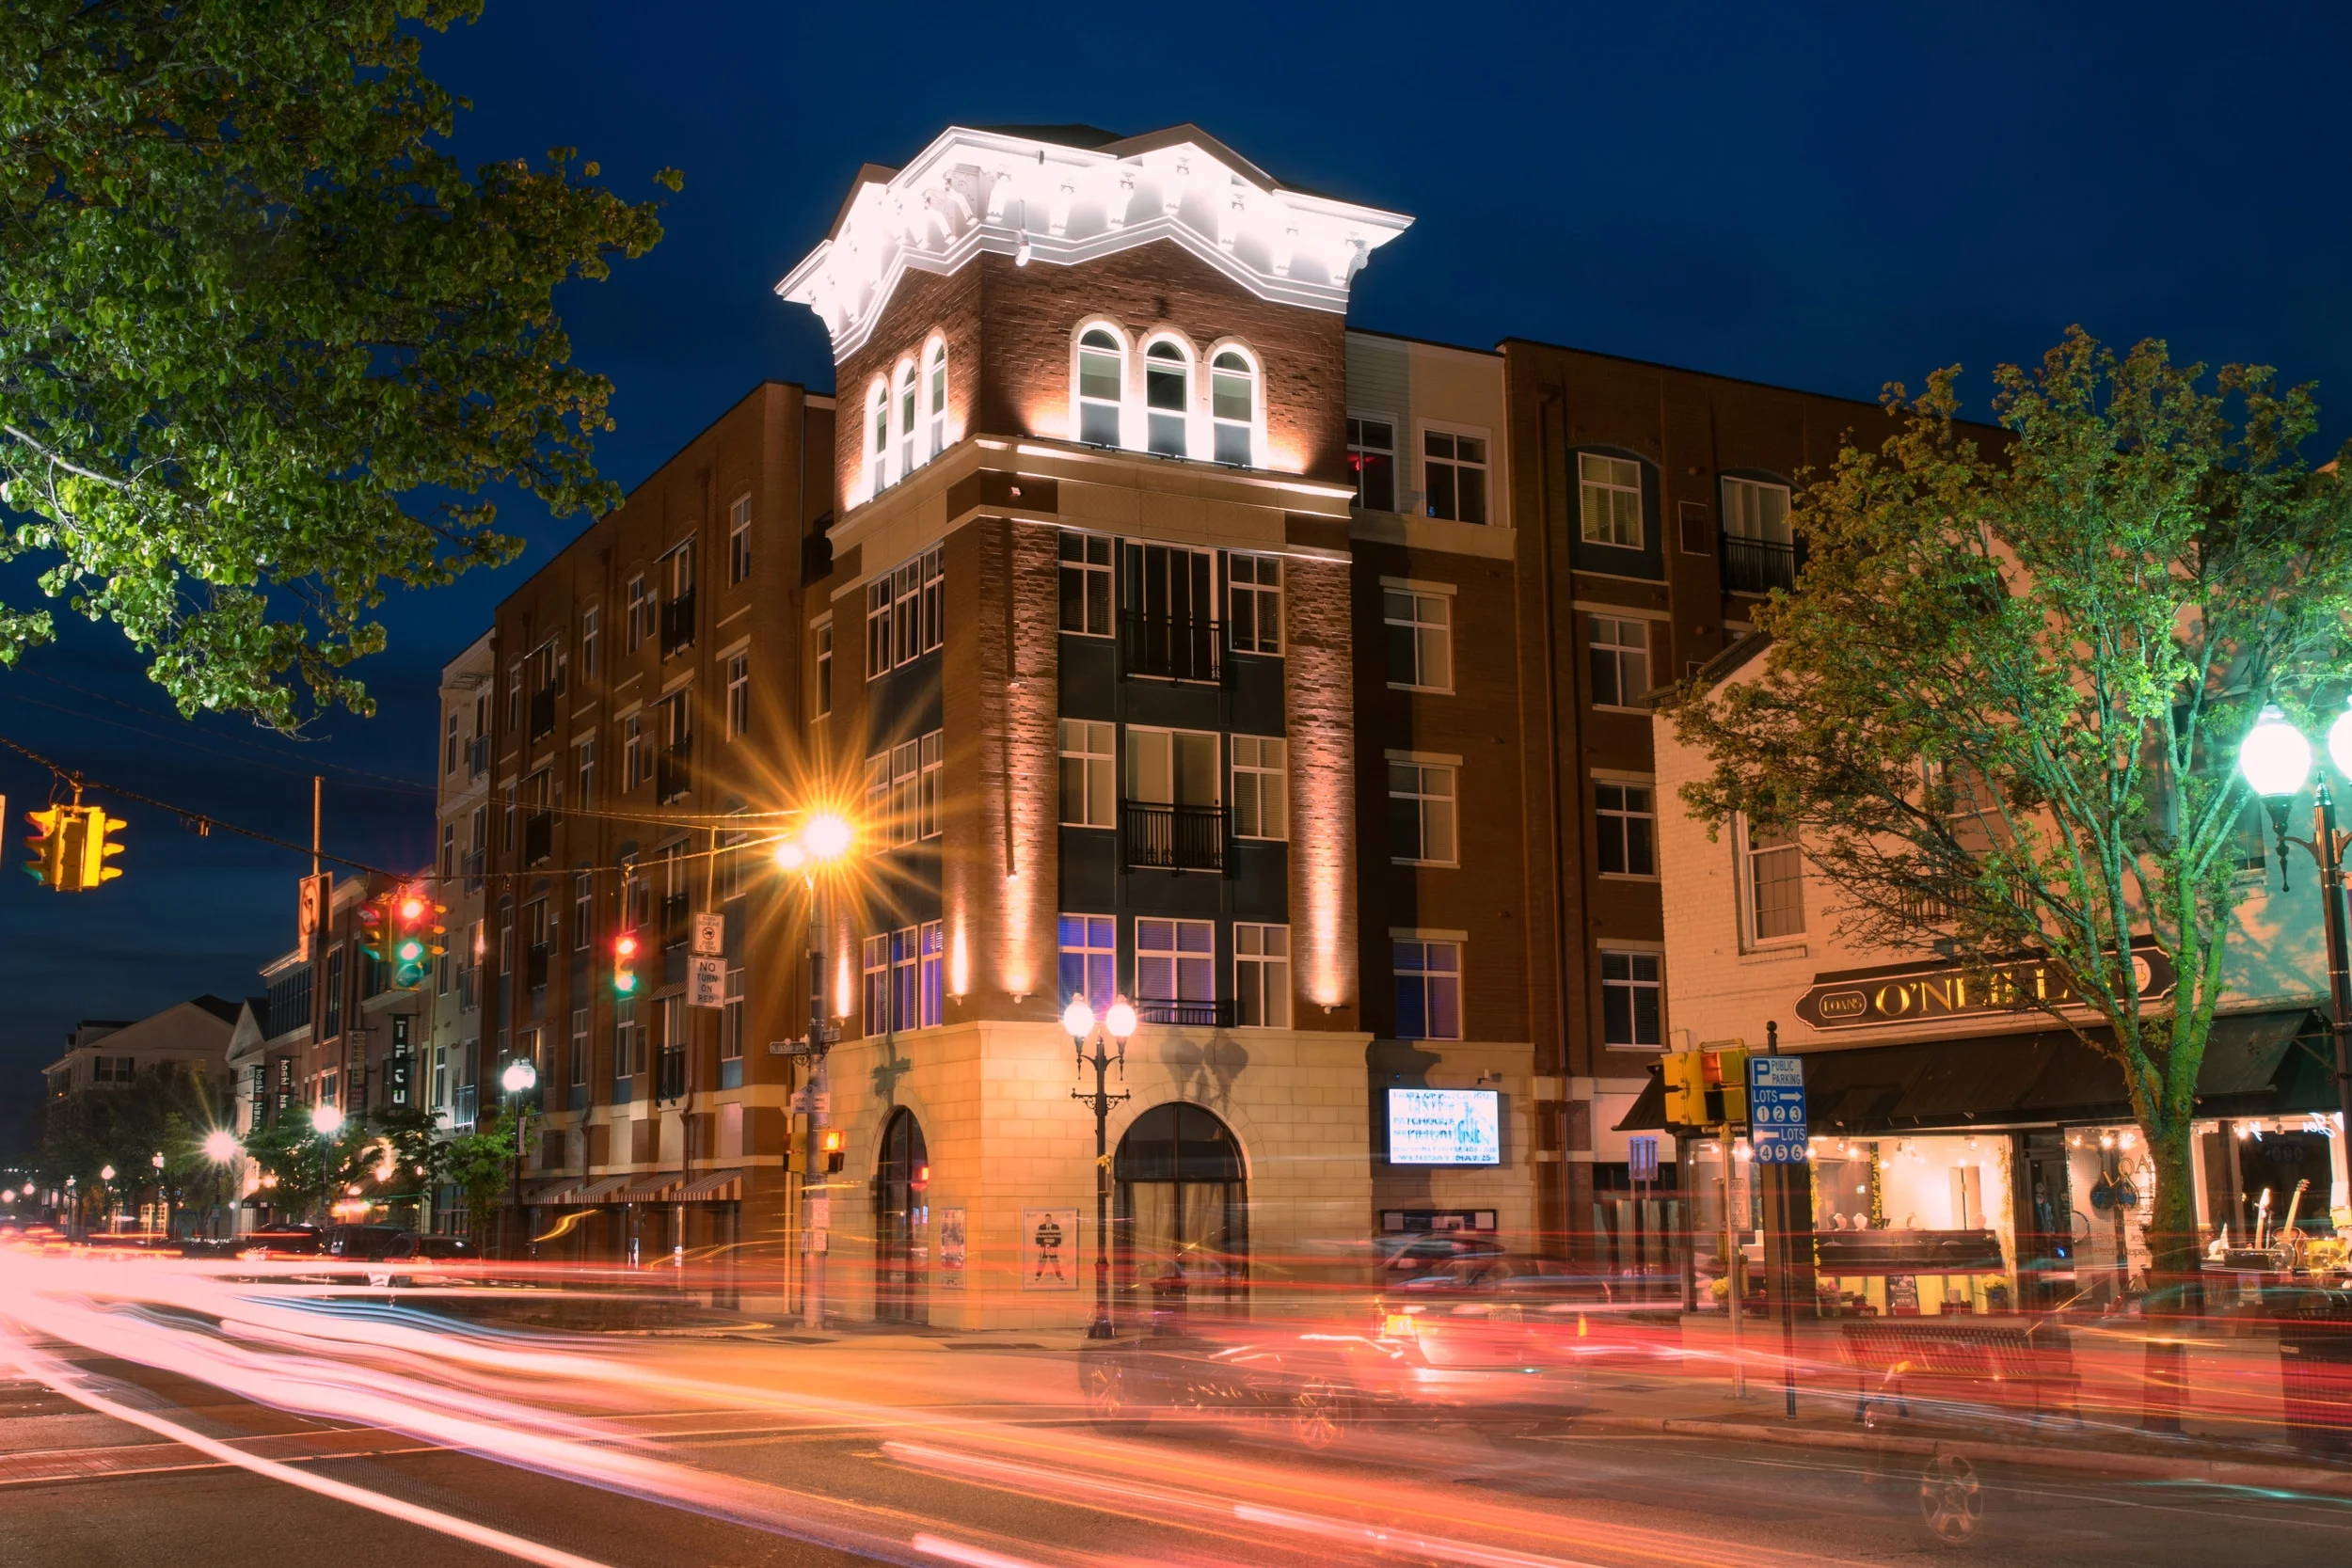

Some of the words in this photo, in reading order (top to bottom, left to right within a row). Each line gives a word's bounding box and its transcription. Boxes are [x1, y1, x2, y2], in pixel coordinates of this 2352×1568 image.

[699, 961, 716, 972] NO
[696, 974, 718, 982] TURN
[701, 984, 712, 992] ON
[698, 994, 714, 1003] RED
[1823, 998, 1863, 1012] LOANS
[1753, 1059, 1771, 1085] P
[1772, 1059, 1794, 1071] PUBLIC
[1772, 1074, 1801, 1085] PARKING
[1753, 1089, 1778, 1102] LOTS
[1775, 1107, 1783, 1120] 2
[1792, 1107, 1799, 1120] 3
[1781, 1128, 1805, 1141] LOTS
[1761, 1147, 1770, 1159] 4
[1777, 1147, 1785, 1159] 5
[1793, 1147, 1801, 1159] 6
